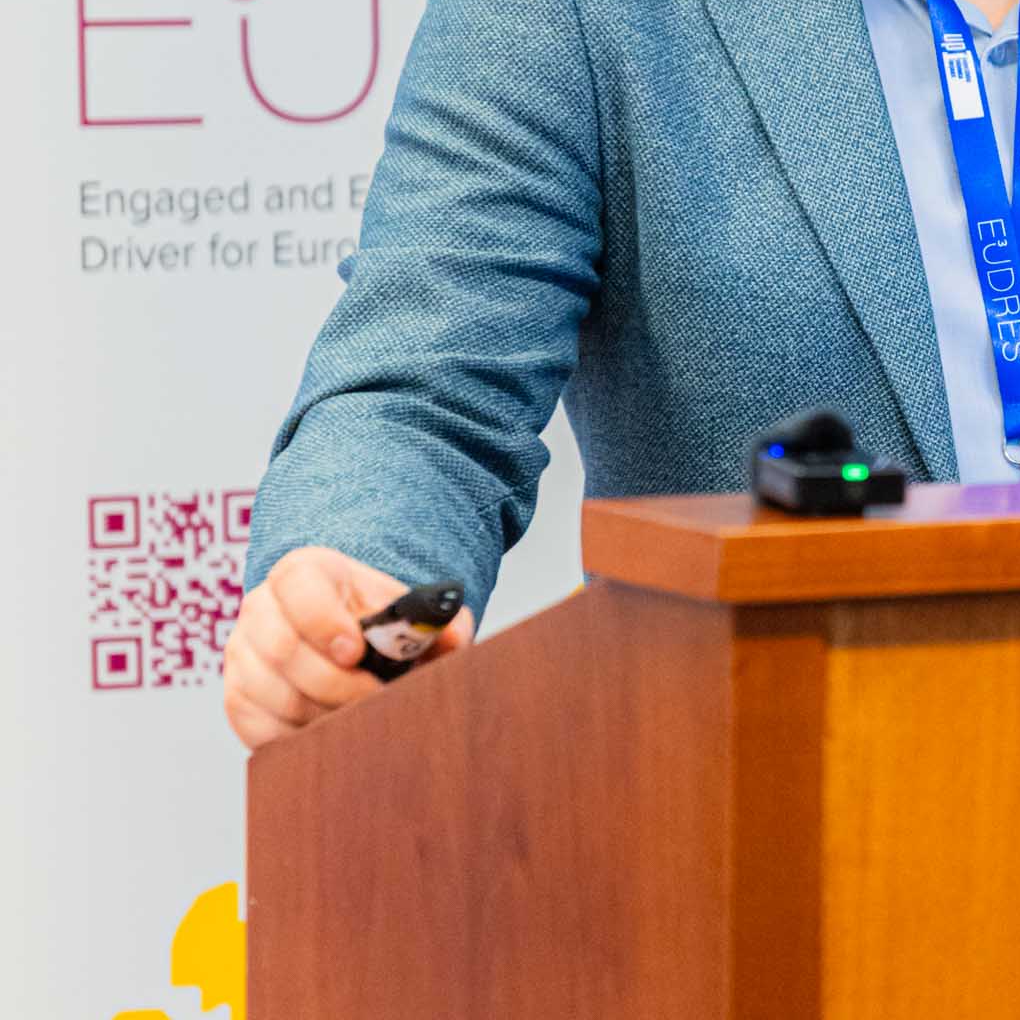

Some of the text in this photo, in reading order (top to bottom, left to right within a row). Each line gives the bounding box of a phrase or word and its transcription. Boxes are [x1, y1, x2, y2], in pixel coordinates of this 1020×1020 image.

[80, 179, 250, 225] Engaged
[264, 176, 334, 213] and
[80, 230, 358, 272] Driver for Euro
